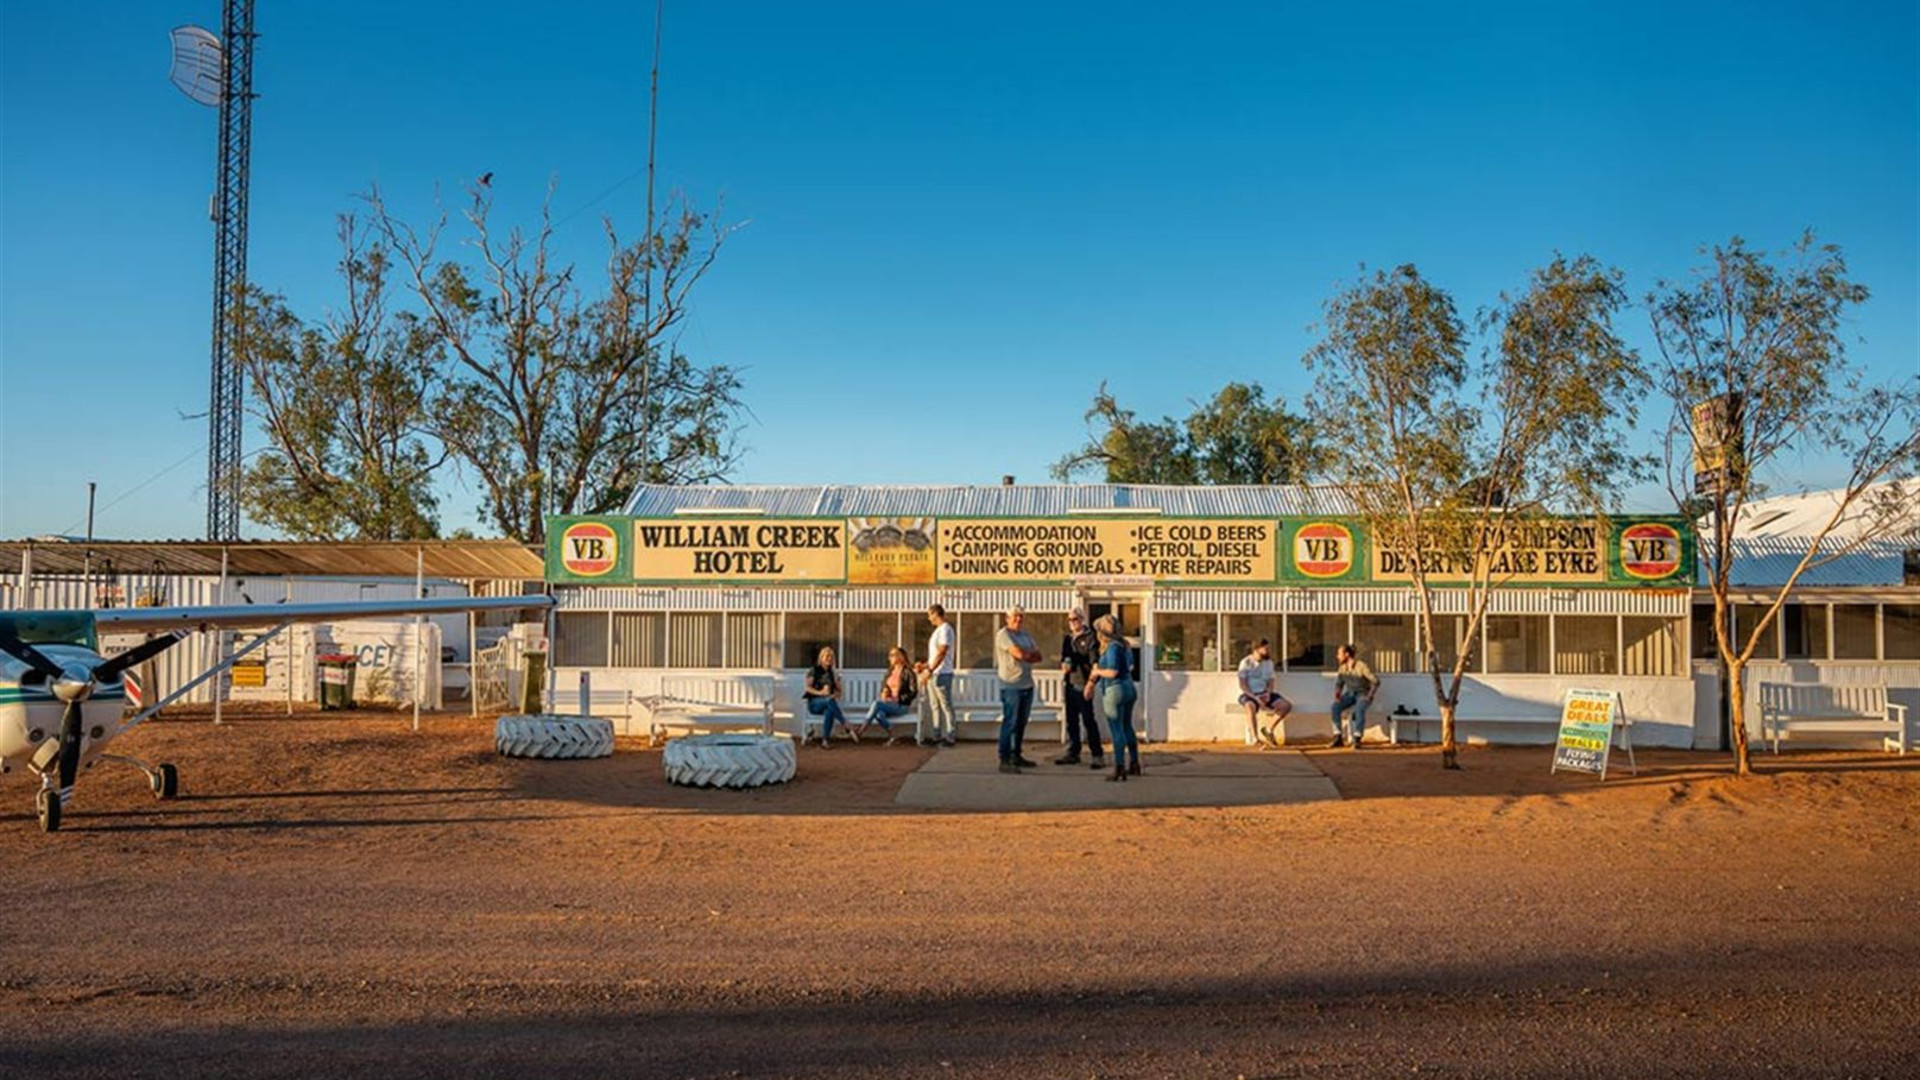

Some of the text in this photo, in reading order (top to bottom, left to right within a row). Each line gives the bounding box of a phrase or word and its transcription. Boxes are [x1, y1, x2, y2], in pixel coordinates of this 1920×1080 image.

[640, 525, 840, 548] WILLIAM CREEK
[952, 525, 1096, 541] ACCOMMODATION
[1138, 525, 1266, 541] ICE COLD BEERS
[1510, 526, 1596, 549] SIMPSON
[571, 538, 604, 559] VB
[951, 542, 1103, 557] CAMPING GROUND
[1138, 542, 1260, 559] PETROL, DIESEL
[1304, 538, 1339, 561] VB
[1628, 539, 1667, 561] VB
[694, 551, 784, 574] HOTEL
[951, 559, 1124, 574] DINING ROOM MEALS
[1140, 559, 1252, 575] TYRE REPAIRS
[1380, 551, 1455, 574] DEERT
[1544, 551, 1598, 574] EYRE
[1569, 700, 1610, 712] GREAT
[1567, 711, 1608, 723] DEALS
[1563, 737, 1593, 747] MEALS
